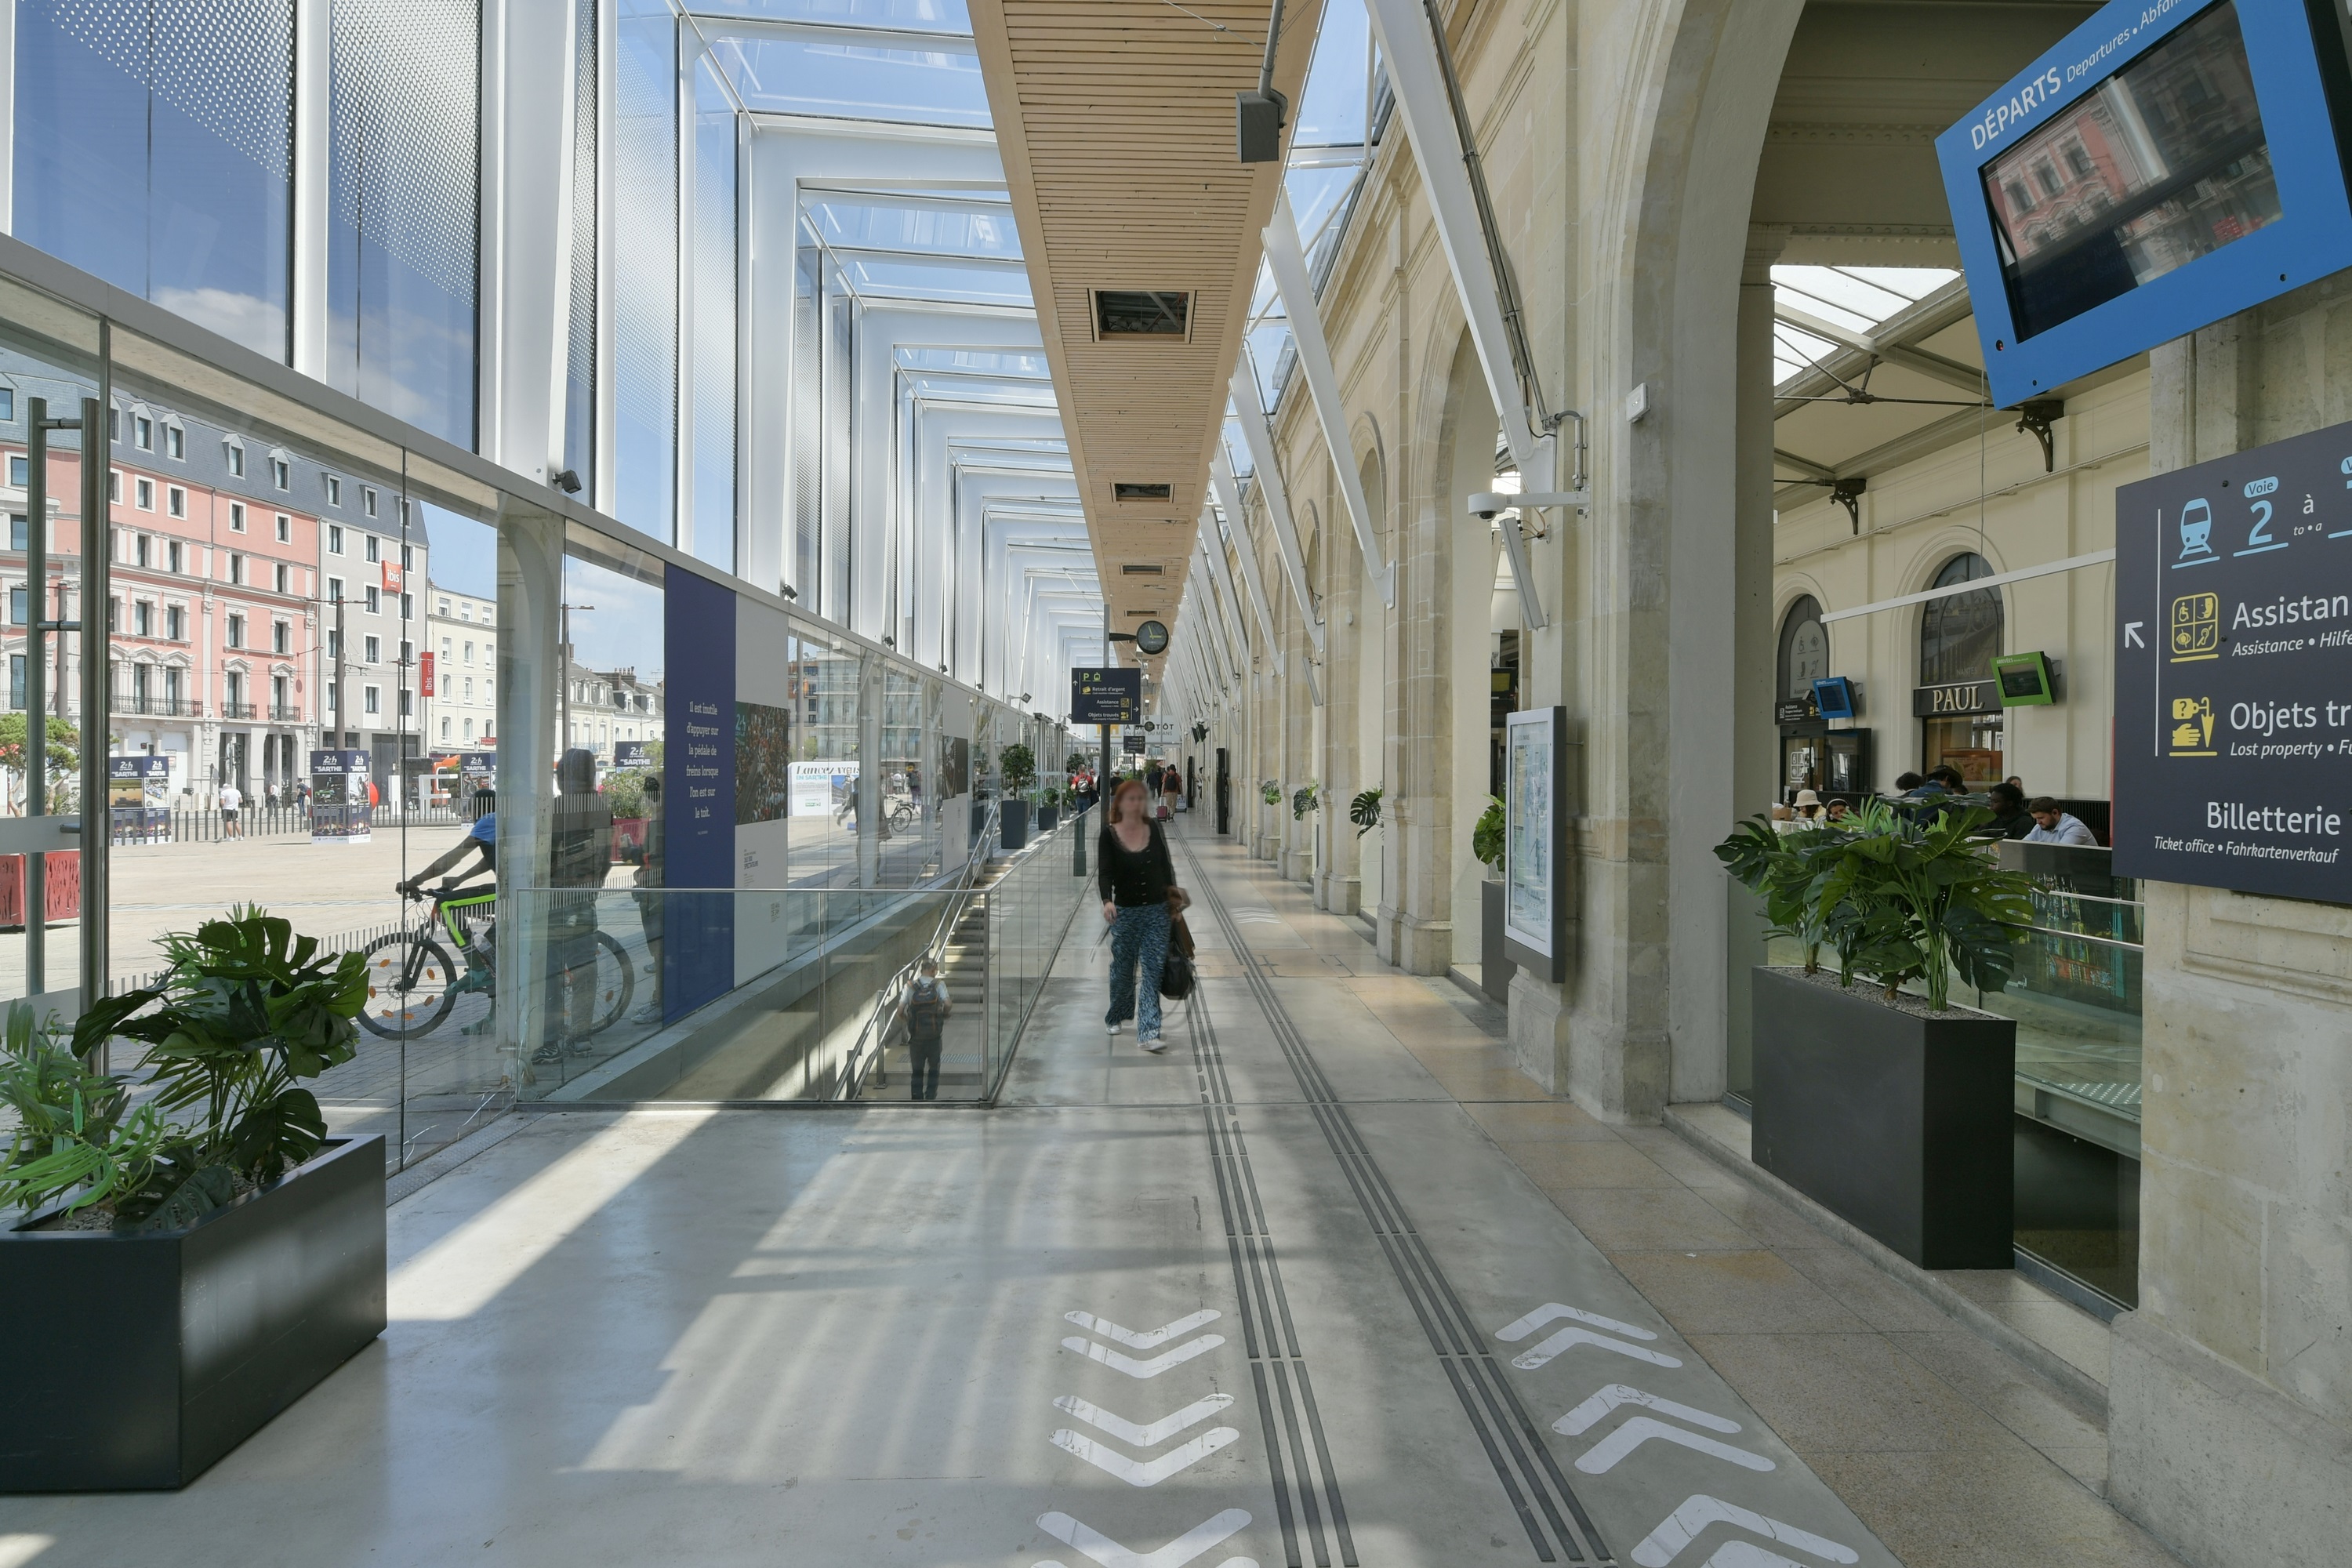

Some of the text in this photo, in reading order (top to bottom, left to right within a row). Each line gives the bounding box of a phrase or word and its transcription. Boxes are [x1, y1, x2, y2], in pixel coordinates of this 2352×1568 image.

[1971, 67, 2061, 151] DÉPARTS
[2067, 28, 2130, 82] Departures
[2248, 481, 2274, 495] Voie
[2249, 494, 2314, 546] 2 à
[2293, 523, 2322, 536] to a
[387, 569, 400, 583] ibis
[2232, 595, 2348, 630] Assistan
[2232, 630, 2352, 656] Assistance Hilfe
[1933, 686, 1985, 713] PAUL
[702, 702, 717, 715] inutile
[2230, 701, 2317, 737] Objets
[686, 722, 710, 737] d'appuyer
[688, 743, 717, 758] la pédale de
[2230, 742, 2258, 757] Lost
[2261, 742, 2323, 759] property
[686, 764, 719, 779] freins lorsque
[689, 786, 699, 797] l'on
[695, 807, 700, 818] le
[2207, 801, 2341, 836] Billetterie
[2154, 836, 2339, 863] Ticket office Fahrkartenverkauf
